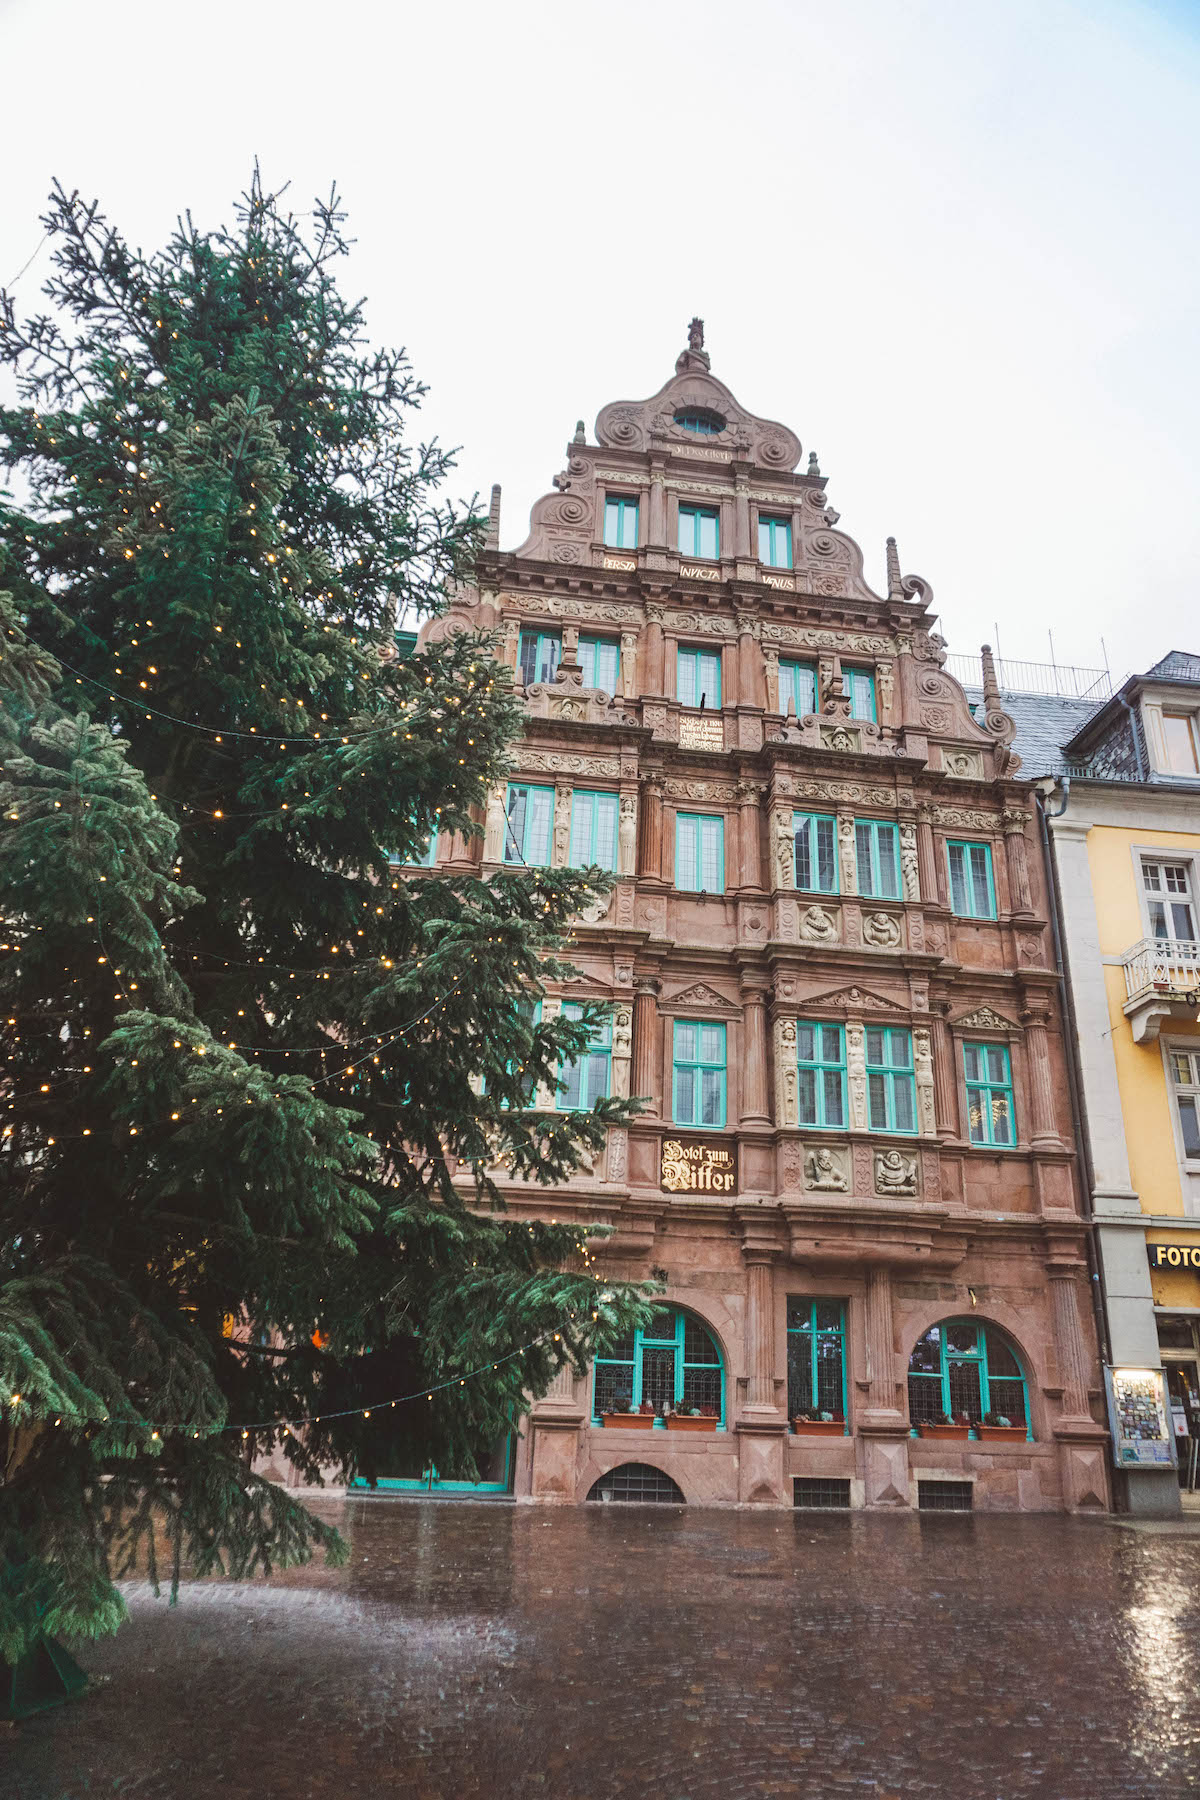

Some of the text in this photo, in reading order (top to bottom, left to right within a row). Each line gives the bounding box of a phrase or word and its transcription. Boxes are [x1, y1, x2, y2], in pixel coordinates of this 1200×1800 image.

[604, 557, 794, 589] PERSTA INVICTA VENUS
[662, 1140, 734, 1169] Hotel zum
[662, 1159, 734, 1191] Ritter
[1156, 1246, 1200, 1267] FOTO
